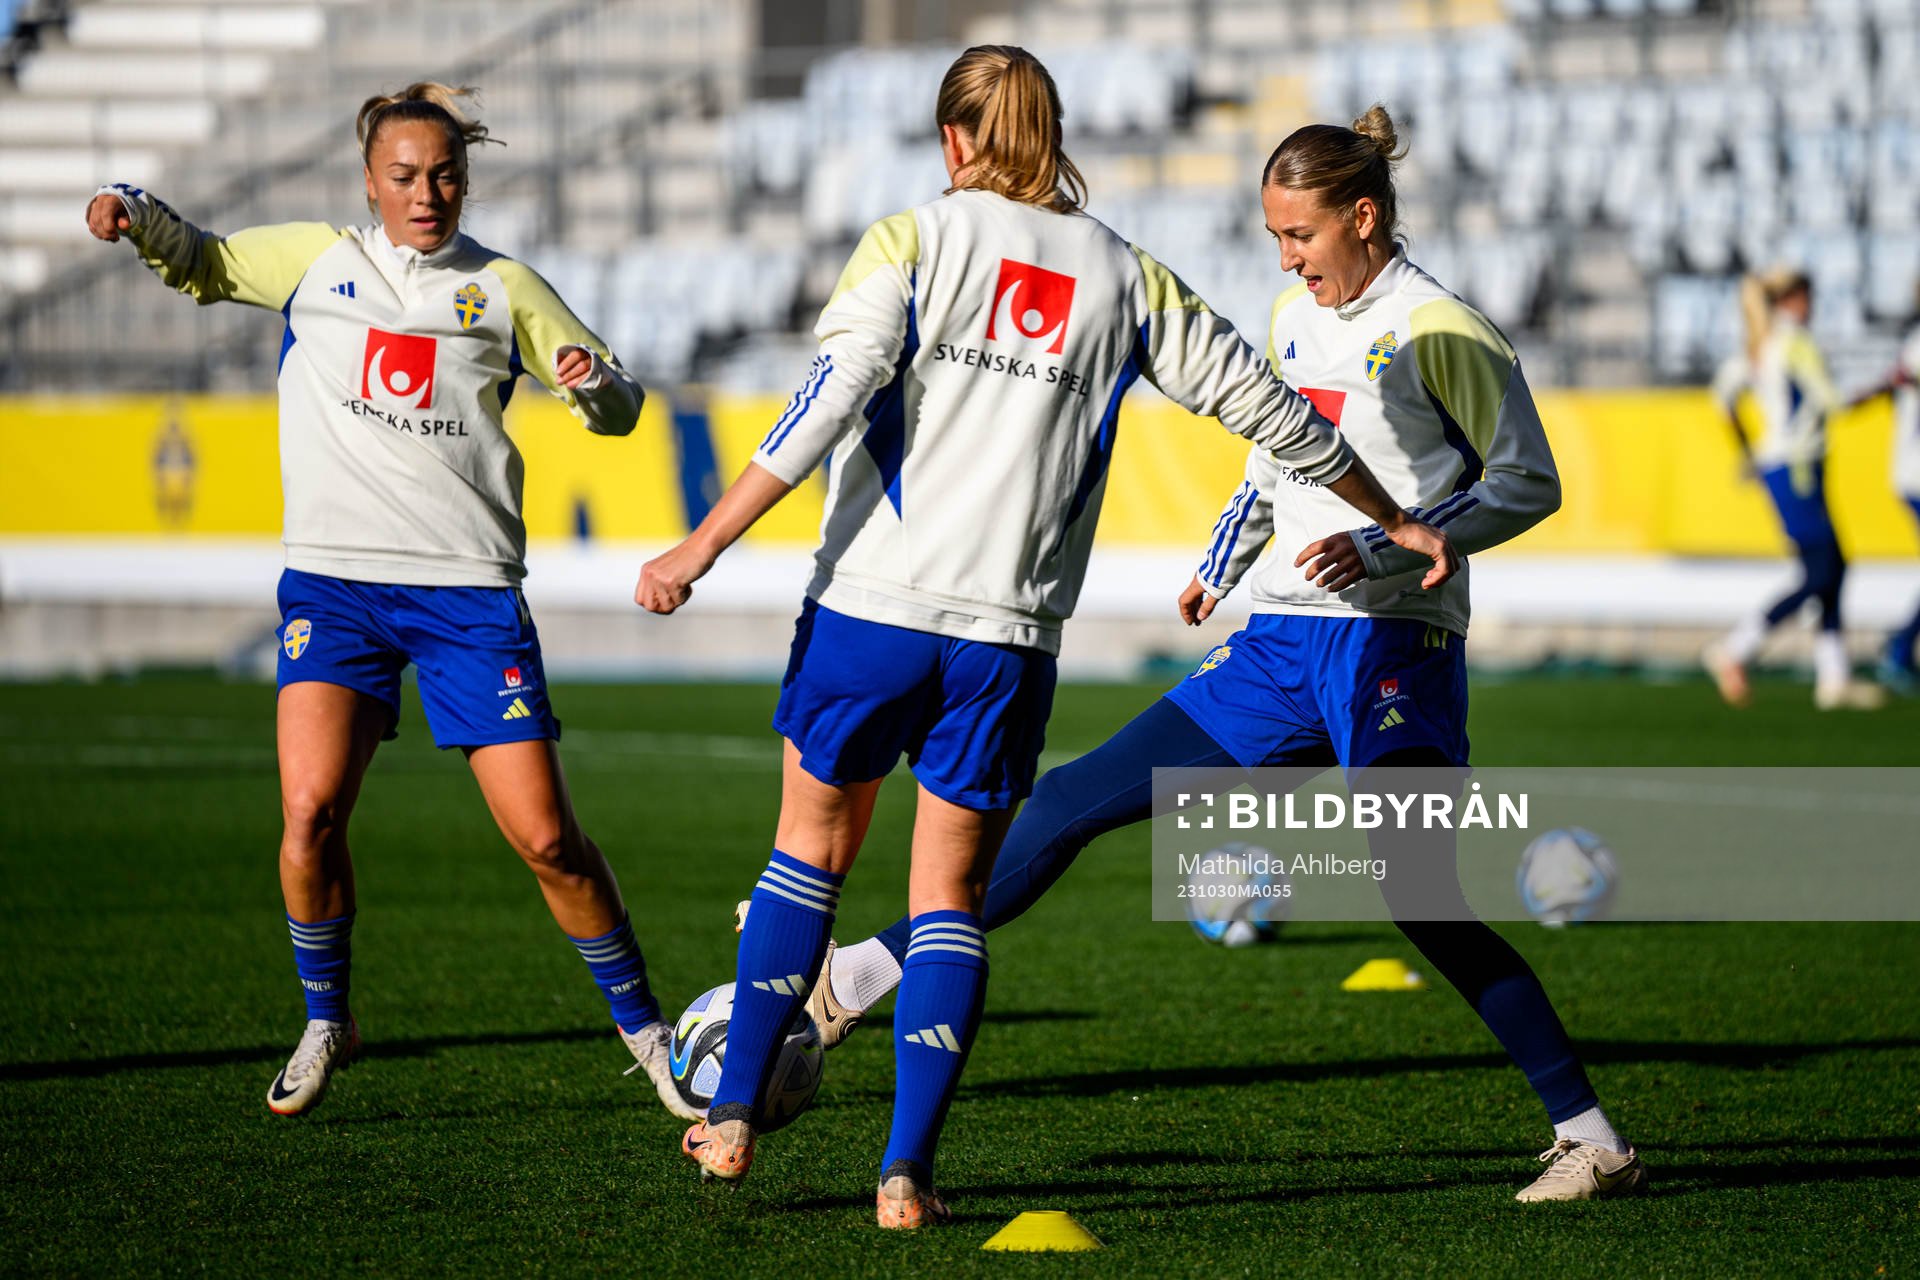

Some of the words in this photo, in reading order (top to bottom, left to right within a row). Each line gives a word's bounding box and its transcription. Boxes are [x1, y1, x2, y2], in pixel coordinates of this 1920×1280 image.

[934, 344, 1036, 379] SVENSKA
[1045, 366, 1088, 396] SPEL
[421, 419, 469, 436] SPEL
